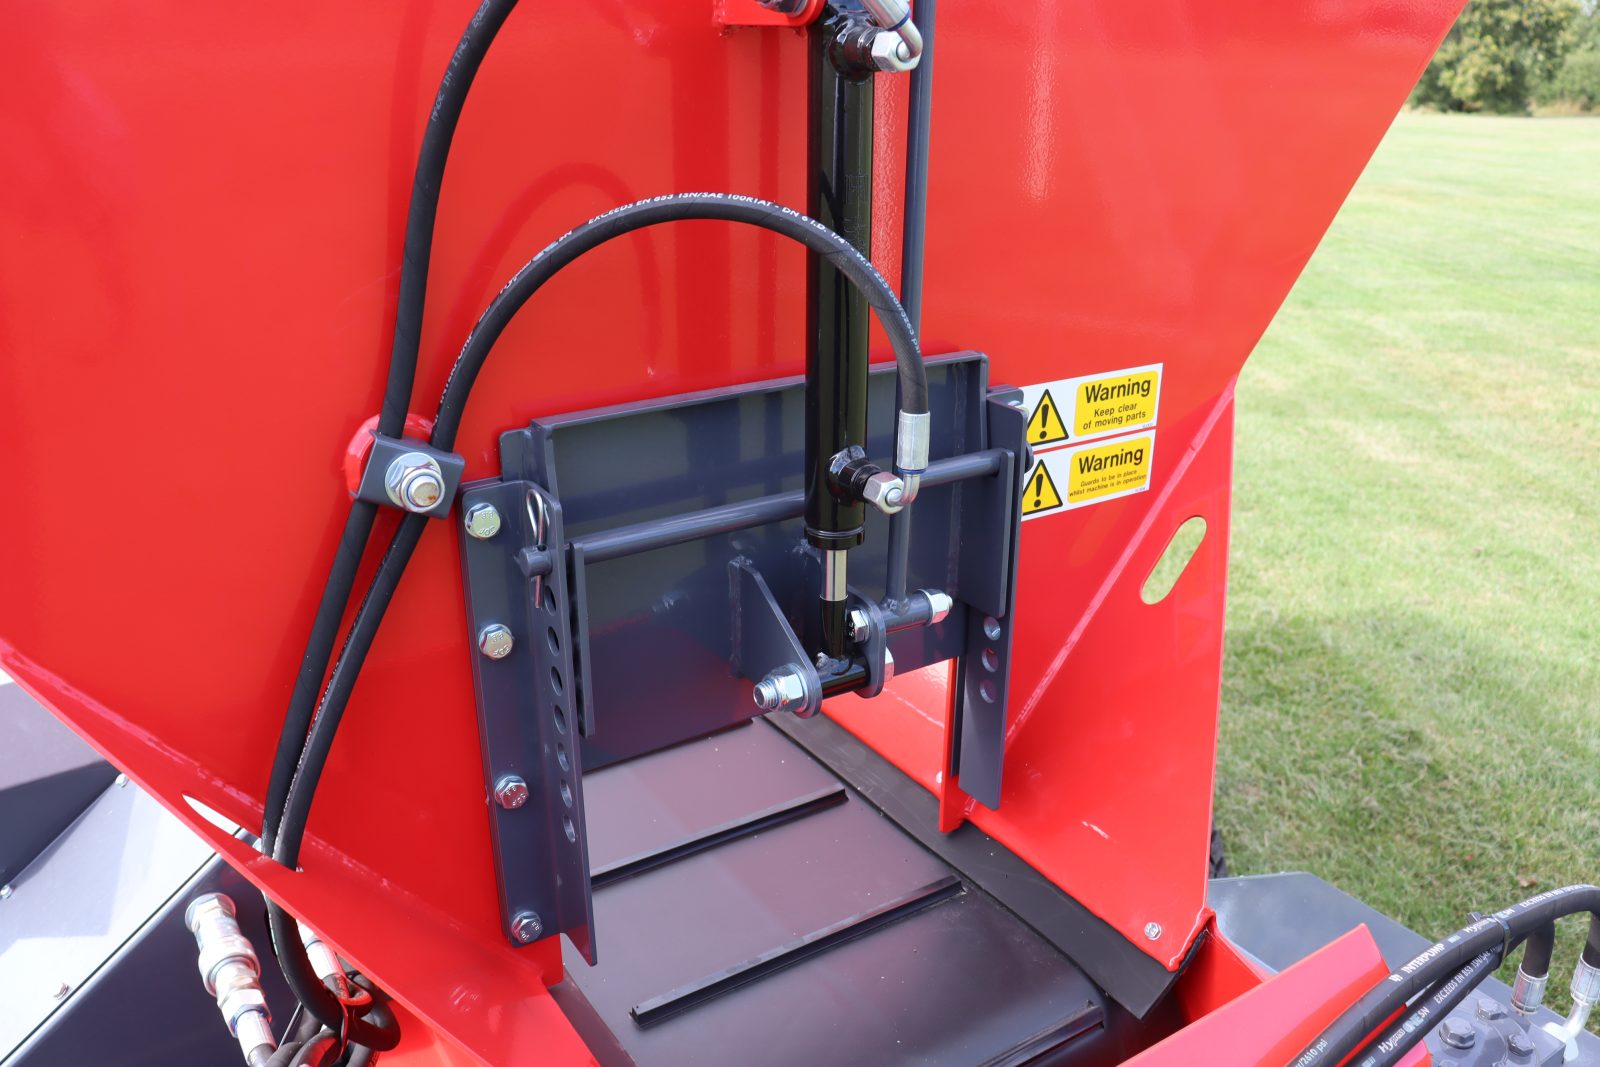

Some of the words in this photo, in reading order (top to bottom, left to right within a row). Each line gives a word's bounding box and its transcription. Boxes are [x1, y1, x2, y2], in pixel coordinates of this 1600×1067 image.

[443, 71, 453, 87] IN
[588, 203, 634, 225] EXCEEDS
[636, 196, 651, 207] EN
[781, 207, 800, 218] DN
[1085, 379, 1151, 403] Warning
[1083, 420, 1092, 430] of
[1095, 416, 1123, 428] moving
[1125, 411, 1146, 423] parts
[1094, 407, 1115, 417] Keep
[1118, 403, 1137, 413] clear
[1079, 448, 1144, 474] Warning
[1069, 488, 1085, 497] whilst
[1086, 483, 1108, 494] machine
[1122, 474, 1147, 485] operation
[1080, 478, 1100, 488] Guards
[1123, 469, 1138, 479] place
[1401, 943, 1445, 974] INTERPUMP
[1433, 980, 1458, 1004] EXCEEDS
[1456, 973, 1465, 985] EN
[1462, 965, 1474, 977] 853
[1316, 1039, 1329, 1053] psi
